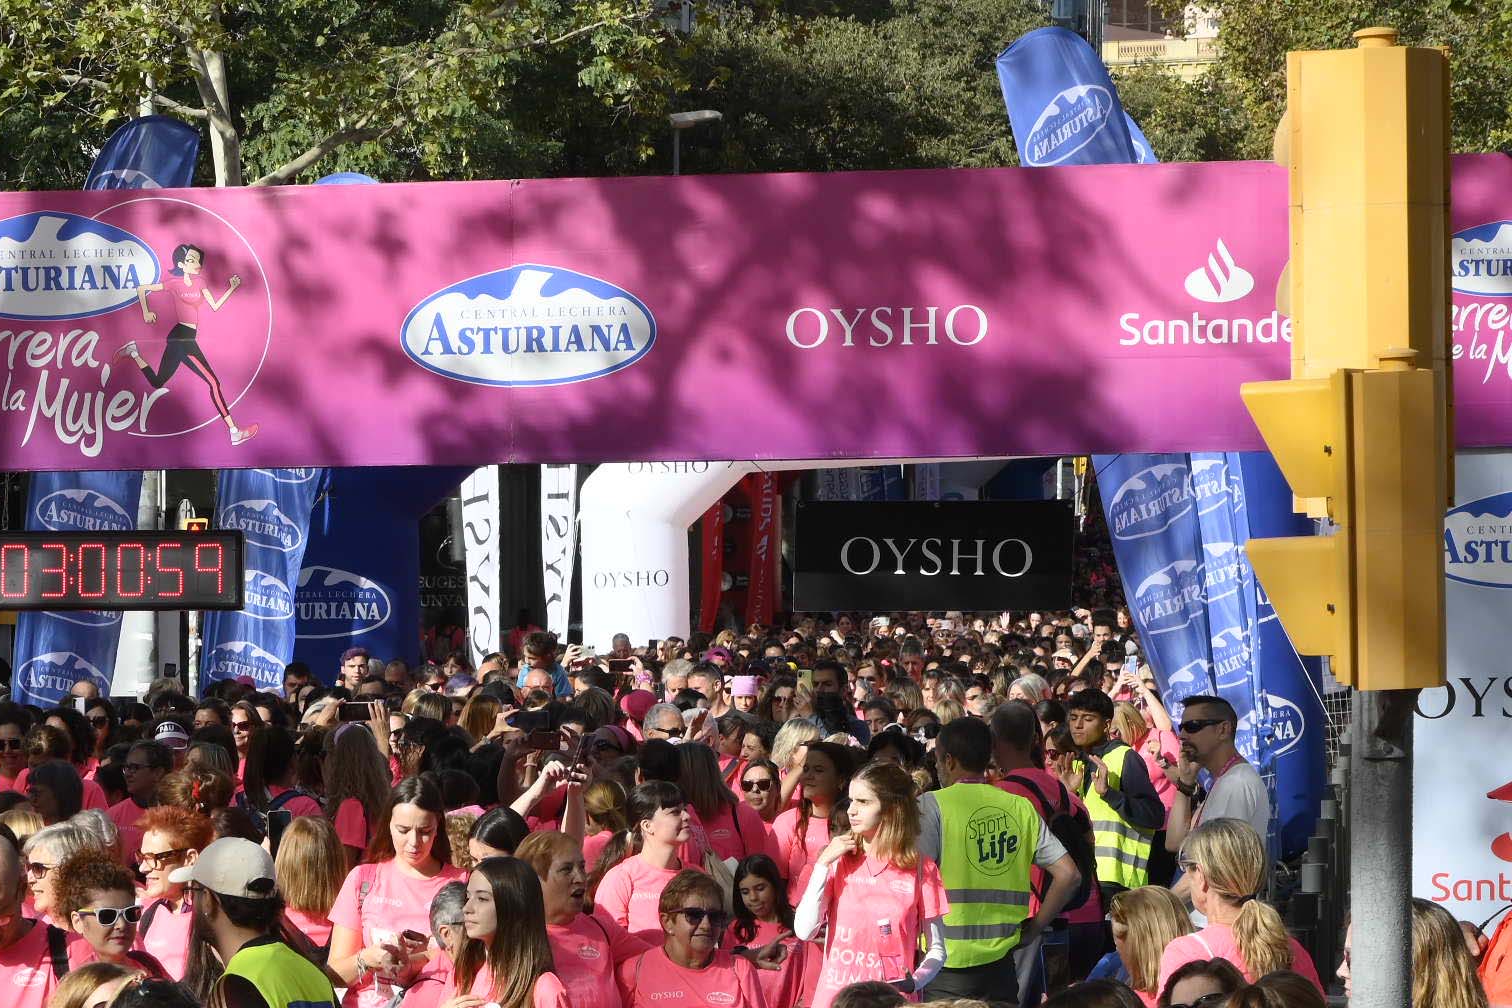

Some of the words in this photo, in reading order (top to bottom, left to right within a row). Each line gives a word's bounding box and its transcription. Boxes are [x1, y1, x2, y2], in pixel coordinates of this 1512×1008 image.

[63, 246, 136, 259] LECHERA
[458, 307, 539, 320] CENTRAL
[547, 304, 628, 318] LECHERA
[785, 304, 989, 348] OYSHO
[1120, 311, 1294, 346] Santande
[421, 312, 636, 357] ASTURIANA
[1, 372, 26, 412] la
[22, 365, 169, 457] Mujer
[1, 543, 223, 598] 03:00:59
[841, 536, 1034, 578] OYSHO
[594, 569, 670, 589] OYSHO
[245, 589, 291, 614] URIANA
[969, 812, 1009, 840] Sport
[978, 830, 1018, 865] Life
[651, 989, 685, 1000] OYSHO
